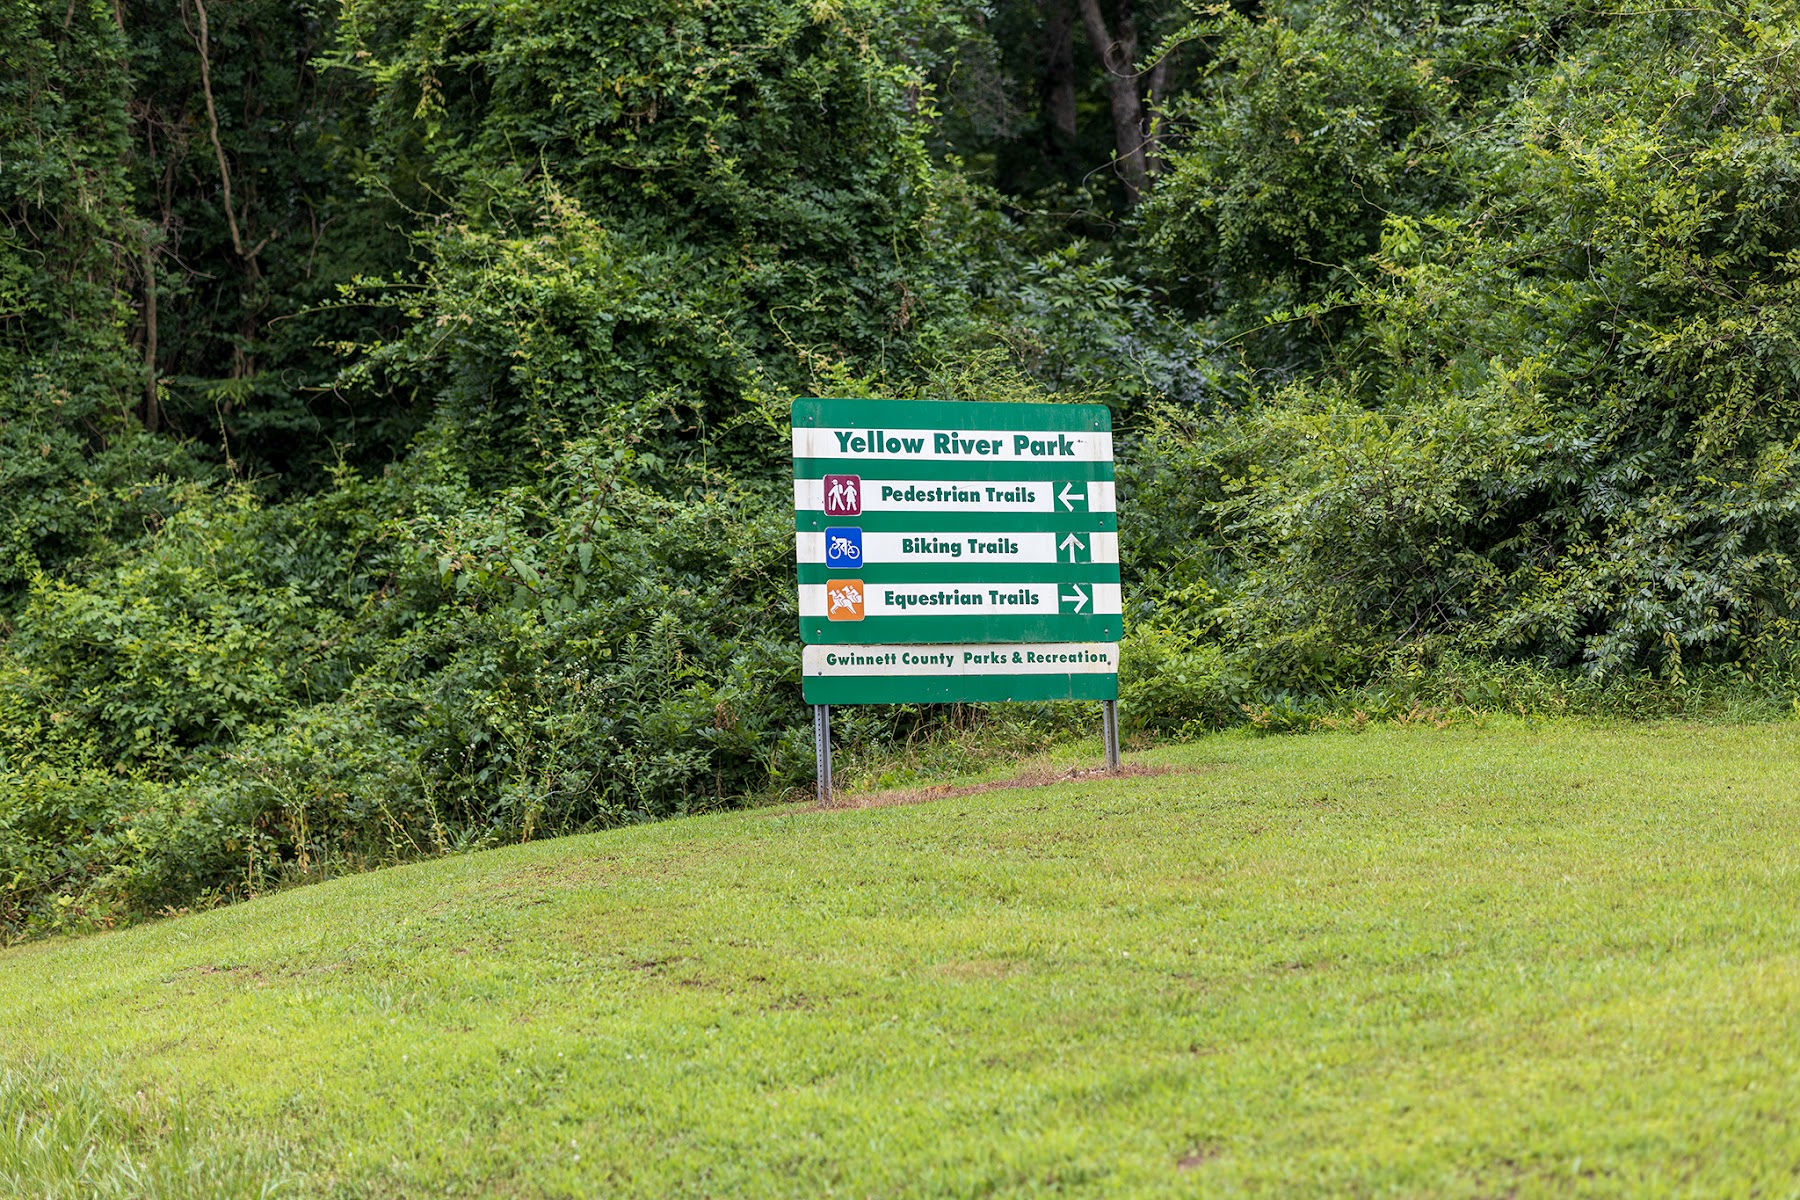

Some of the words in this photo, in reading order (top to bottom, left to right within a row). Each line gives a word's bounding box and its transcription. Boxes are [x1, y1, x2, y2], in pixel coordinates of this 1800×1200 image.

[834, 431, 925, 454] Yellow
[933, 432, 1003, 455] River
[1013, 435, 1075, 456] Park
[881, 485, 981, 503] Pedestrian
[985, 487, 1036, 503] Trails
[902, 538, 962, 557] Biking
[968, 538, 1019, 554] Trails
[885, 590, 983, 609] Equestrian
[989, 589, 1039, 605] Trails
[826, 652, 897, 666] Gwinnett
[902, 652, 954, 668] County
[963, 651, 1007, 664] Parks
[1011, 651, 1023, 664] &
[1027, 650, 1107, 664] Recreation
